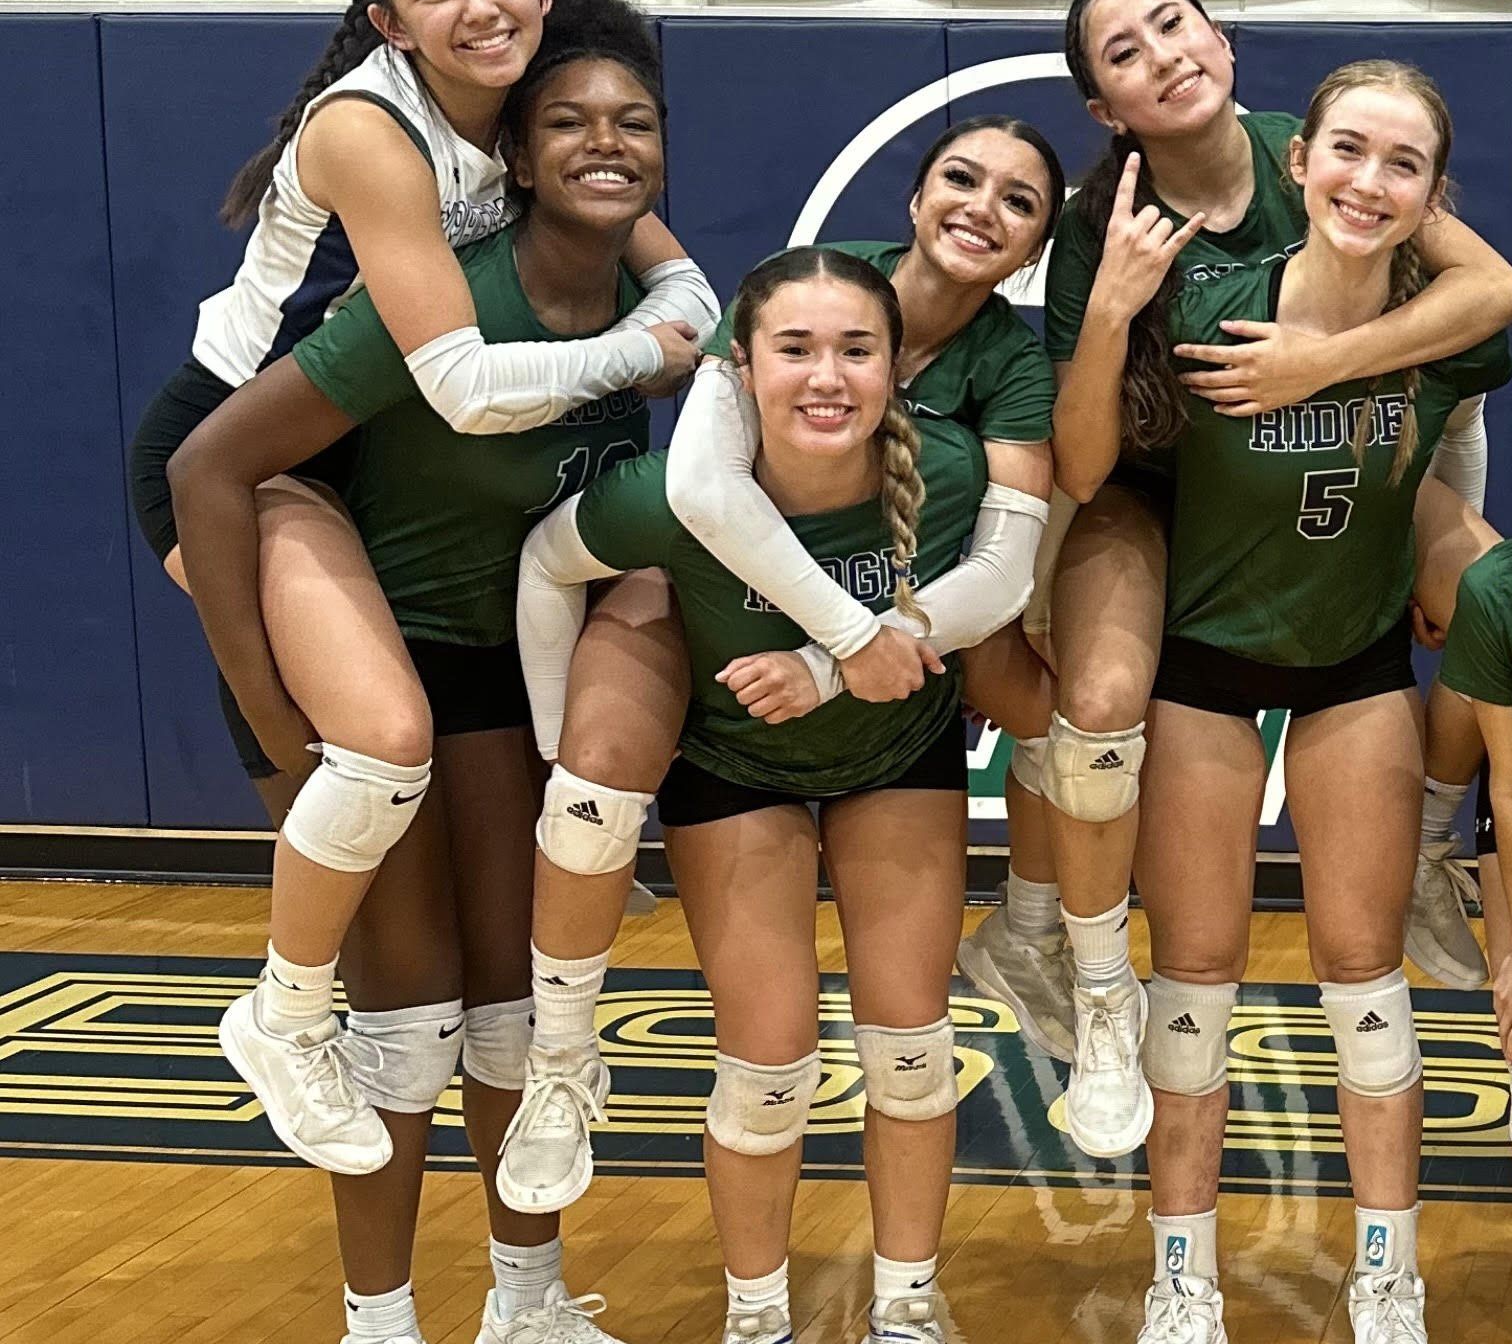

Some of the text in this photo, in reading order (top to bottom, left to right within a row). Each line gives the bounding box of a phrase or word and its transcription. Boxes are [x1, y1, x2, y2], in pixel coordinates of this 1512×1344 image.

[1249, 393, 1409, 452] RIDGE
[1296, 467, 1360, 540] 5
[567, 806, 604, 826] adidas
[1168, 1023, 1201, 1035] adidas
[1356, 1021, 1390, 1033] adidas
